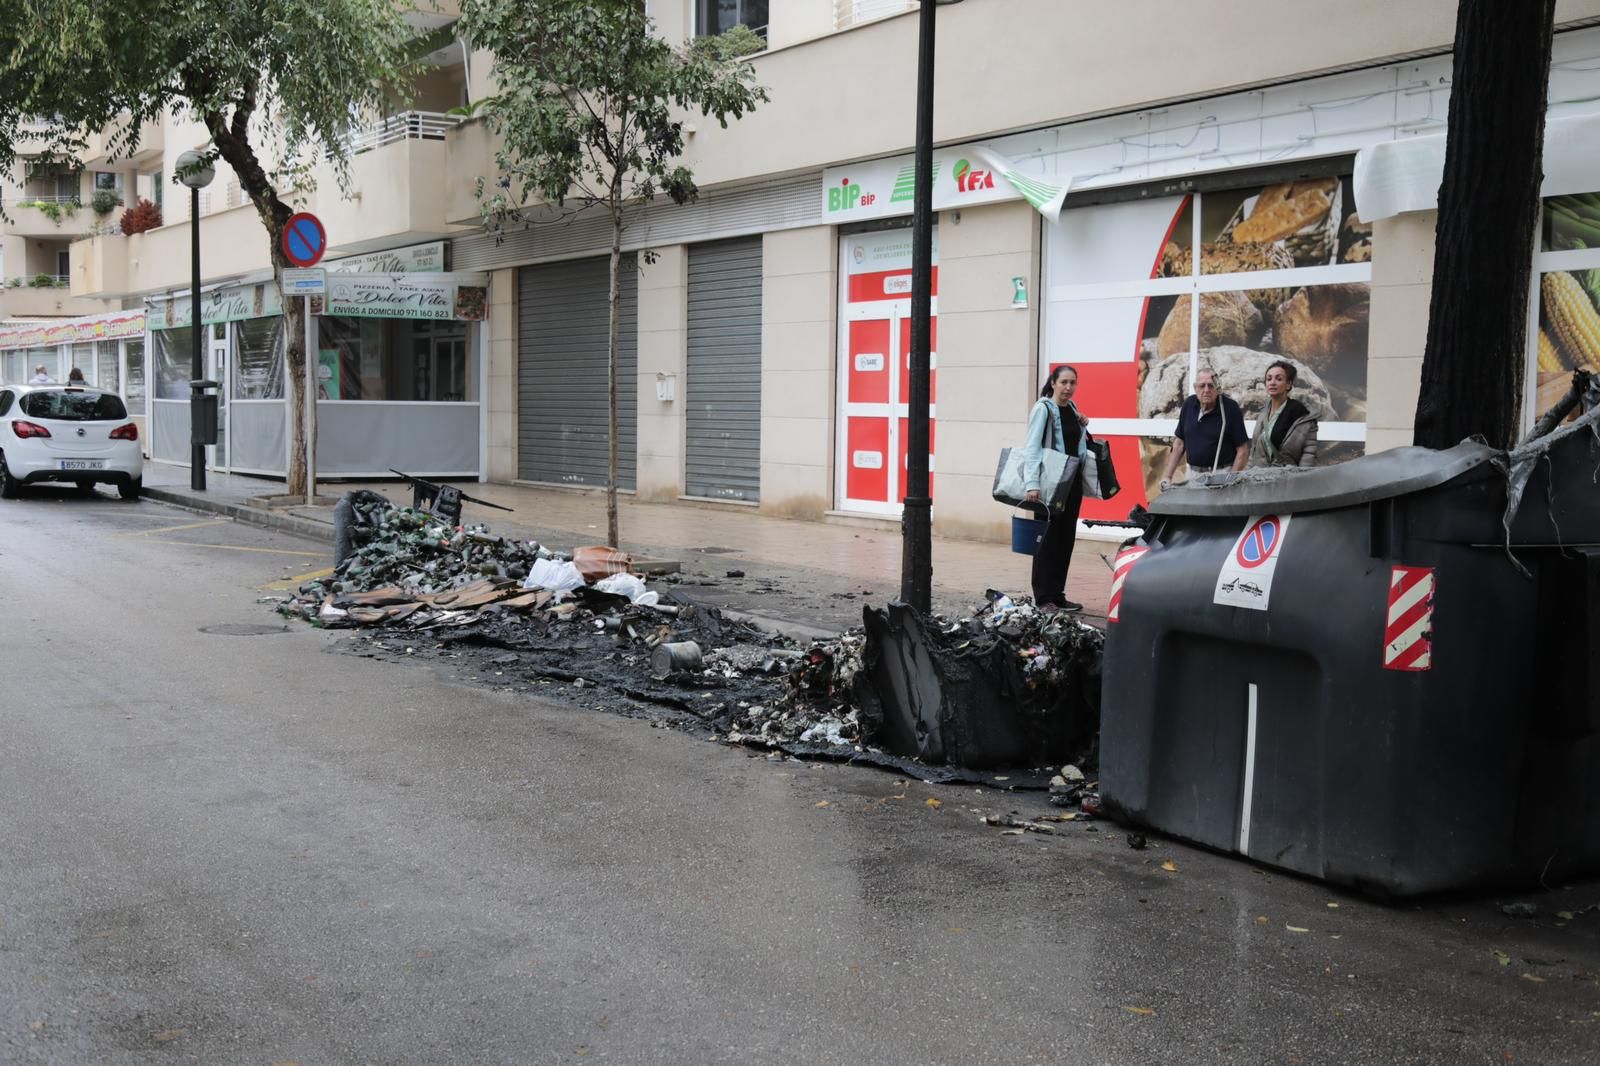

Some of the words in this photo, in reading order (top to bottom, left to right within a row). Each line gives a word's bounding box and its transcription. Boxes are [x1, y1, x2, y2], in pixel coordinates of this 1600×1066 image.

[354, 290, 404, 304] Dolce
[406, 293, 450, 307] Vita
[368, 308, 405, 316] DOMICILIO
[406, 309, 418, 317] 971
[435, 310, 449, 318] 823
